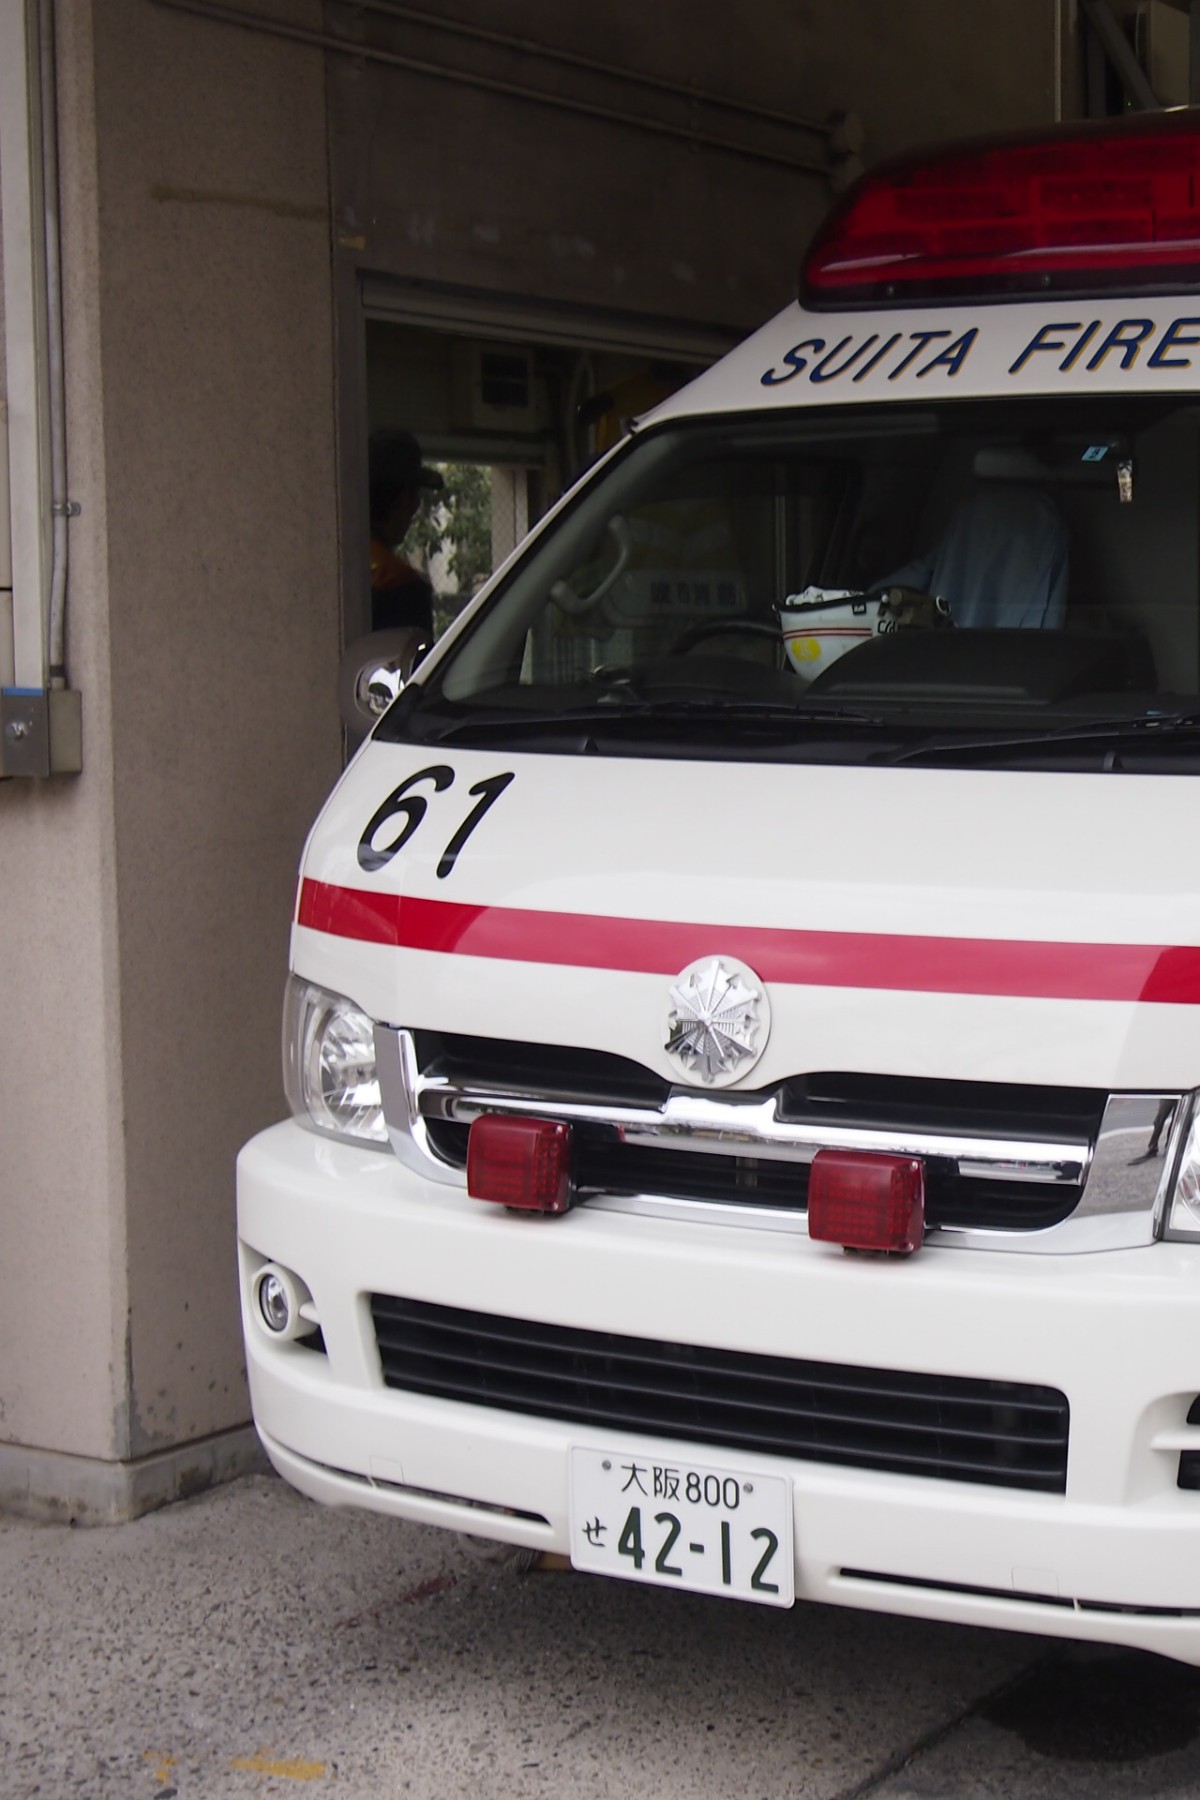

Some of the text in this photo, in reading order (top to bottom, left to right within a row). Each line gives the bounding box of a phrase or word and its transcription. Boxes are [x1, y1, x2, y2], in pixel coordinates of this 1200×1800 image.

[760, 327, 979, 386] SUITA
[356, 764, 516, 880] 61
[582, 1506, 780, 1594] せ 42-12
